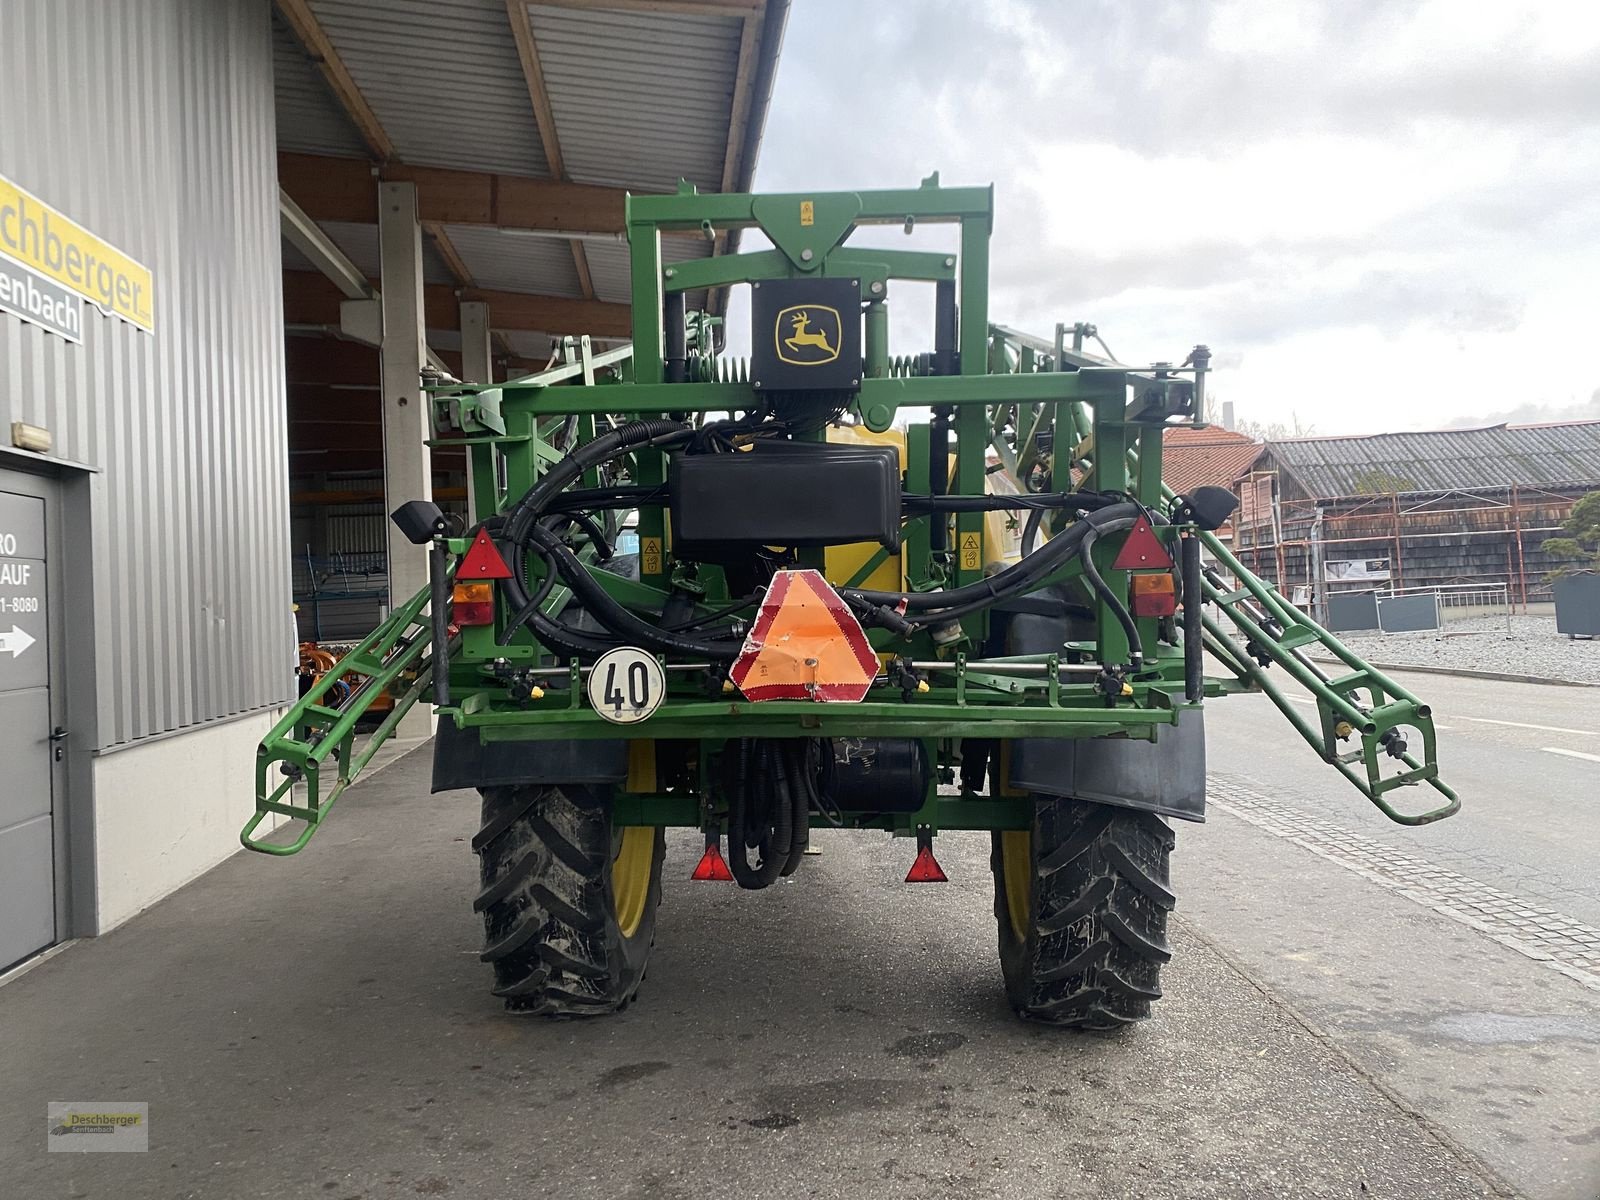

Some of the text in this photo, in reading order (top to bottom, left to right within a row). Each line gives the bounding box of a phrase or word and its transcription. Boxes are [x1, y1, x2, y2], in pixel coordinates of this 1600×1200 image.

[0, 196, 142, 313] chberger
[0, 272, 78, 333] enbach
[604, 661, 649, 710] 40
